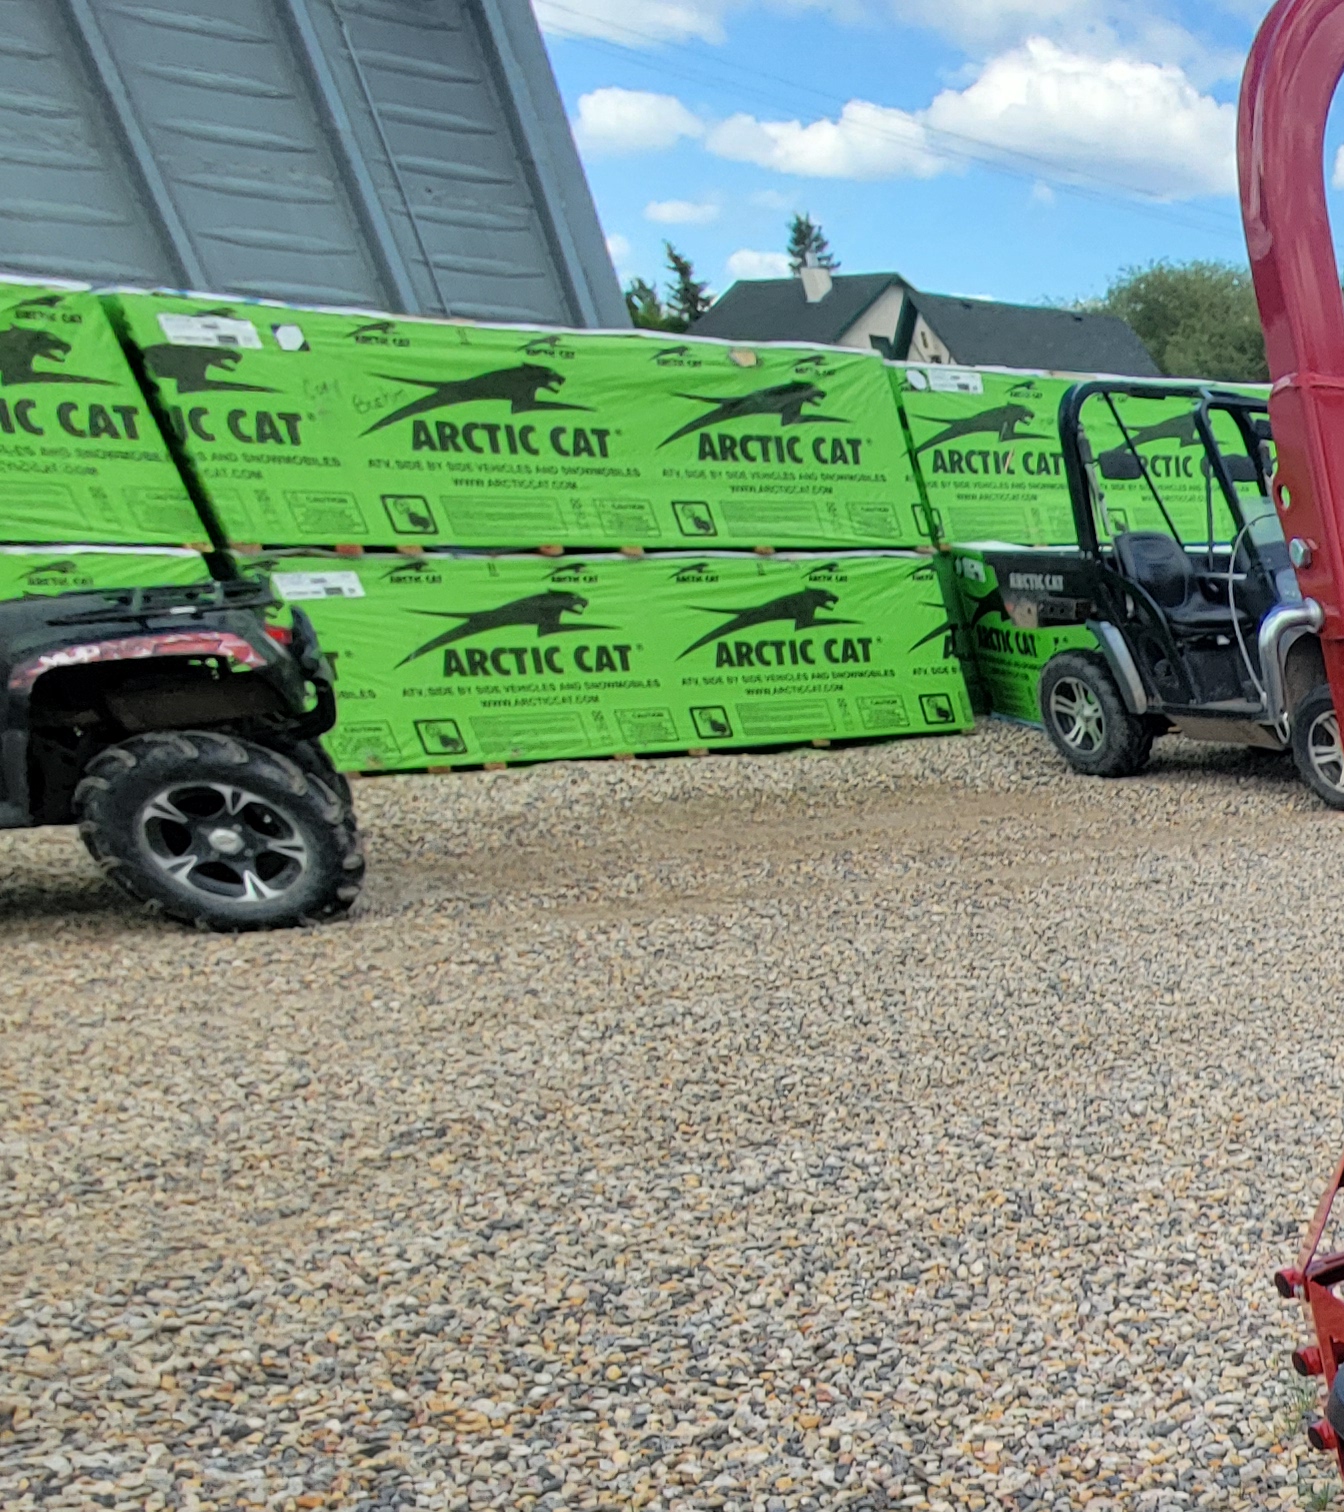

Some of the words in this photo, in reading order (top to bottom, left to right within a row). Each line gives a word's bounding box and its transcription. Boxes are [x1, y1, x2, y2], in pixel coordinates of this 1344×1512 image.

[57, 402, 139, 440] CAT
[227, 408, 302, 446] CAT
[412, 420, 540, 456] ARCTIC
[550, 426, 611, 458] CAT
[698, 432, 804, 465] ARCTIC
[812, 435, 862, 465] CAT
[932, 450, 1015, 475] ARCTIC
[1022, 452, 1064, 476] CAT
[1141, 455, 1193, 478] CTIC
[1009, 573, 1043, 590] ARCTIC
[1045, 574, 1063, 590] CAT
[715, 638, 816, 668] ARCTIC
[823, 637, 873, 663] CAT
[977, 625, 1013, 655] ARCTIC
[1016, 630, 1037, 658] CAT
[443, 646, 564, 678] ARCTIC
[573, 645, 632, 673] CAT
